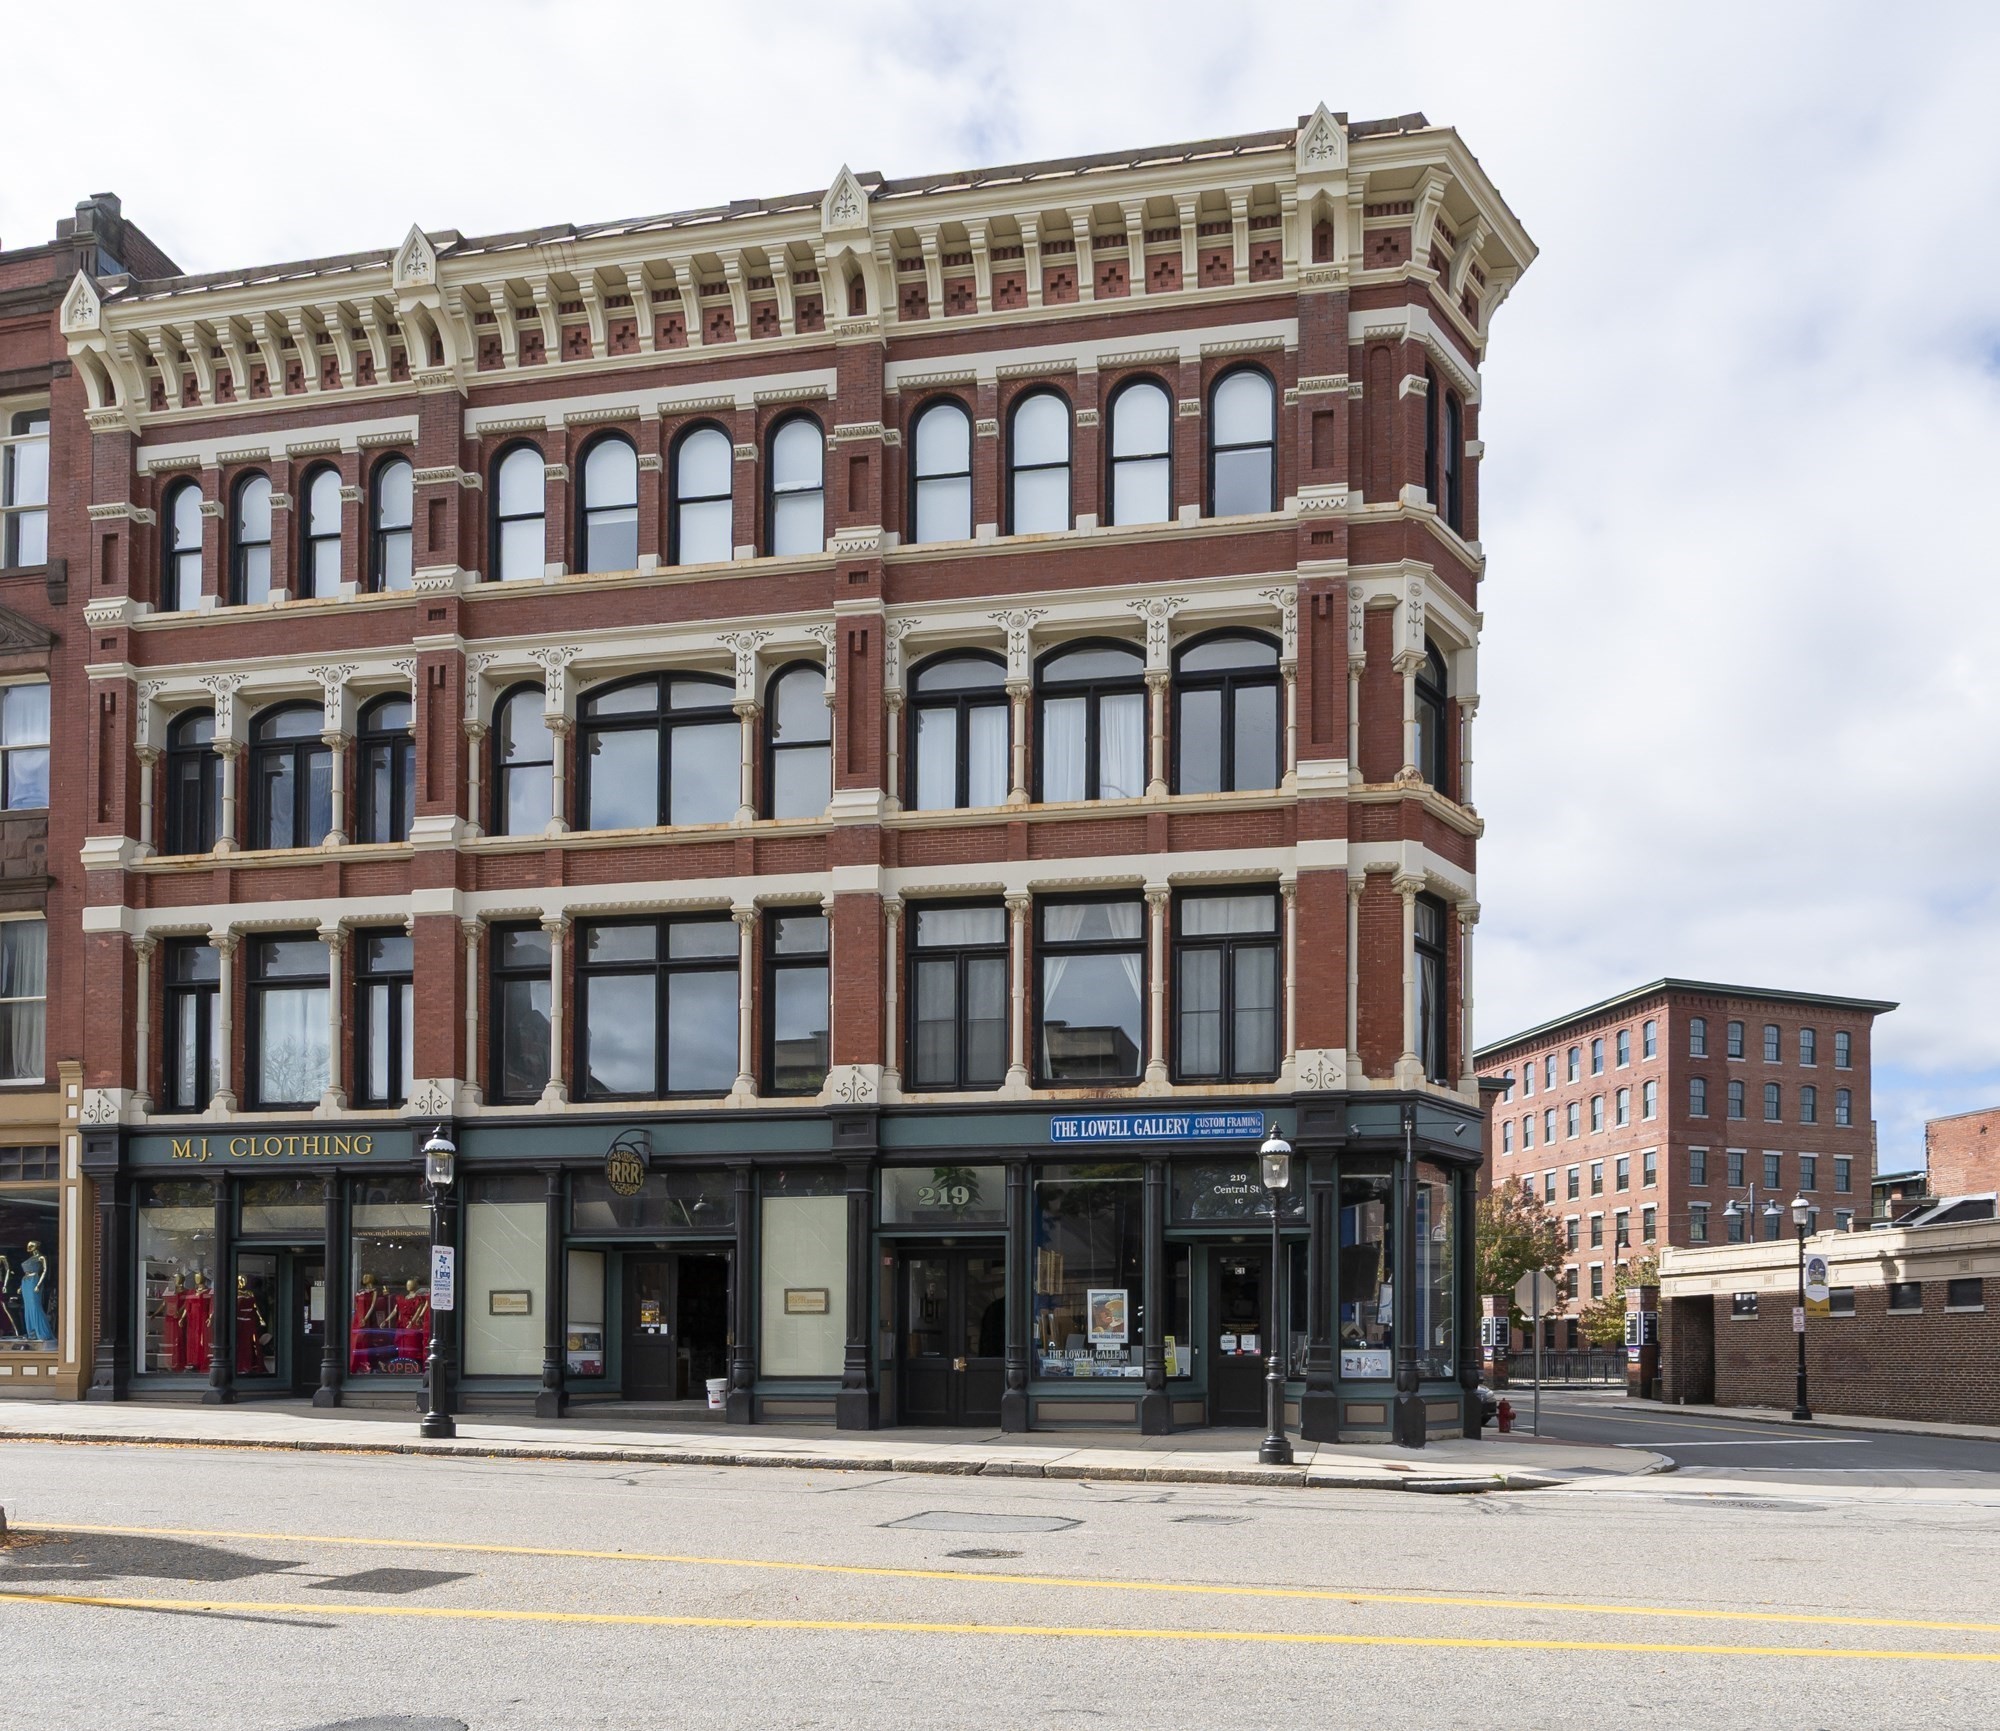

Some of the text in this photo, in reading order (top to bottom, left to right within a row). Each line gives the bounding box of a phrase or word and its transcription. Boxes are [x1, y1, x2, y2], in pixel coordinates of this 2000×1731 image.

[1053, 1117, 1190, 1138] THE LOWELL GALLERY
[1195, 1116, 1261, 1128] CUSTOM FRAMING
[171, 1135, 373, 1162] M.J. CLOTHING
[611, 1160, 640, 1184] RRR
[1230, 1174, 1247, 1182] 219
[1213, 1184, 1260, 1194] Central St
[918, 1185, 970, 1206] 219
[1049, 1349, 1129, 1360] THE LOWELL GALLERY
[387, 1362, 419, 1374] OPEN
